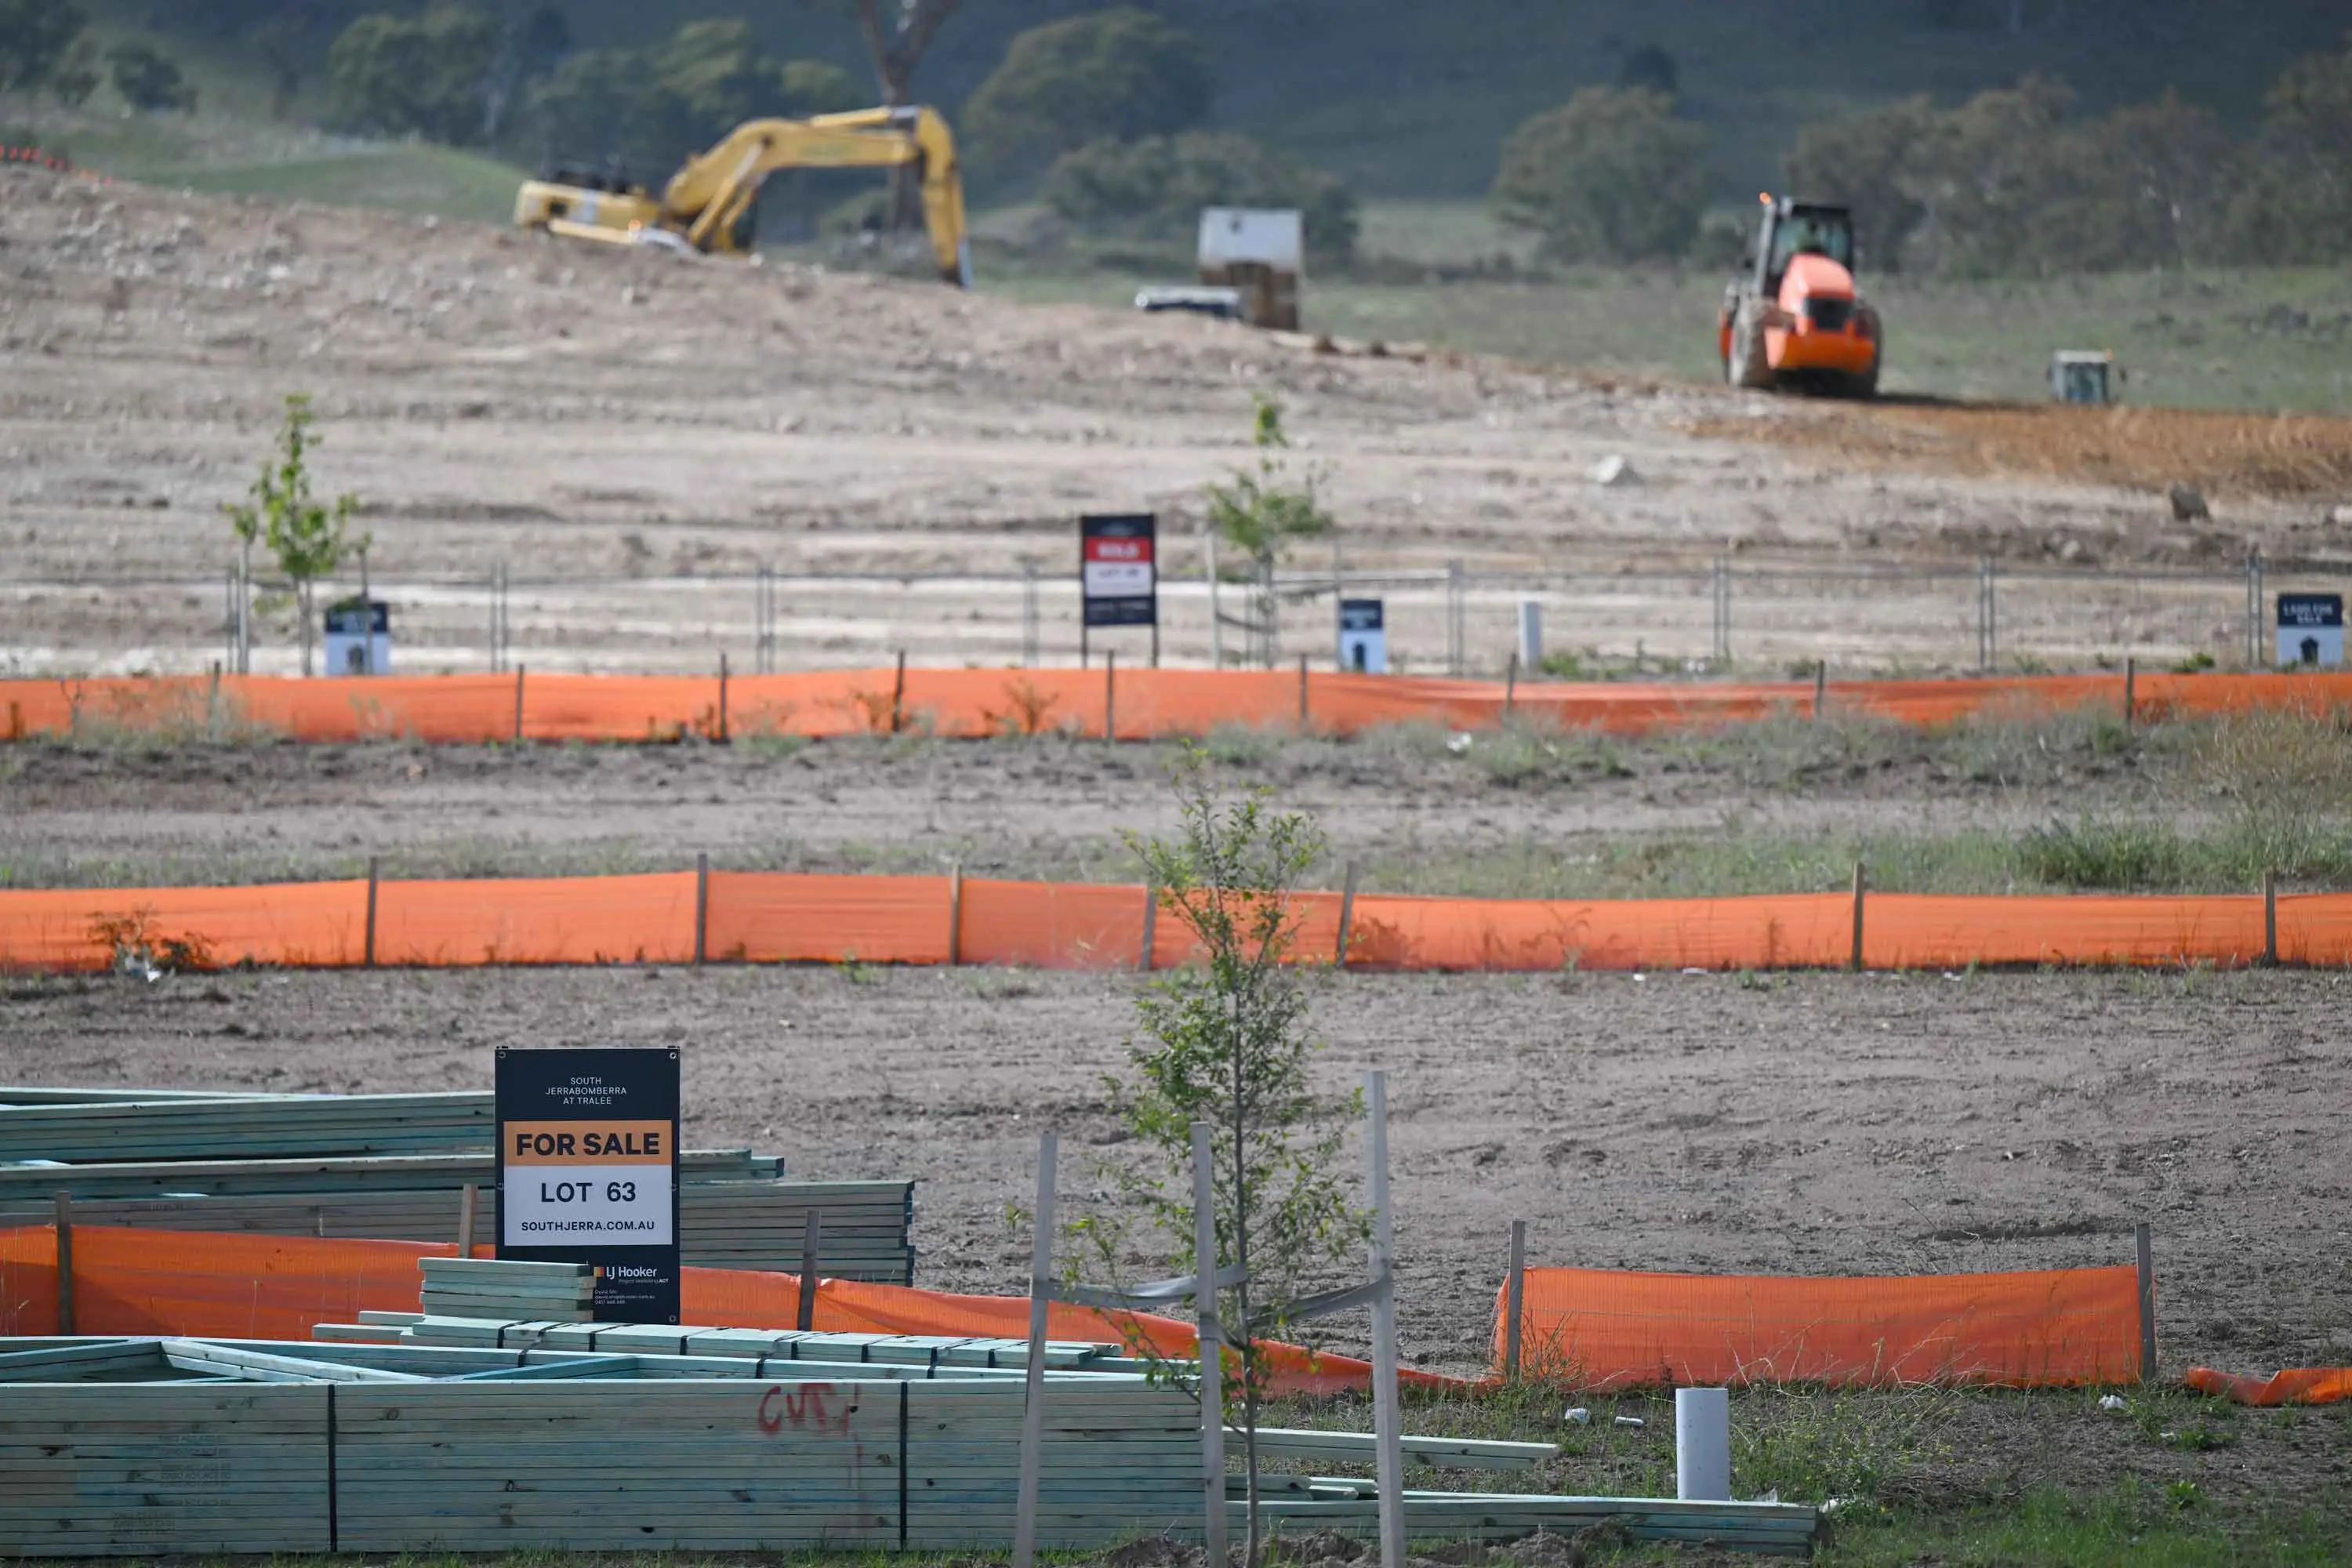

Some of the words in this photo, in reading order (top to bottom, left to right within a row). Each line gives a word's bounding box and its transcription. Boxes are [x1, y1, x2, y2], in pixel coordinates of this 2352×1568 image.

[570, 1076, 602, 1085] SOUTH
[545, 1087, 627, 1095] JERRABOMBERRA
[516, 1133, 576, 1156] FOR
[583, 1132, 660, 1156] SALE
[541, 1182, 593, 1203] LOT
[607, 1181, 637, 1202] 63
[521, 1221, 655, 1232] SOUTHJERRA.COM.AU
[606, 1266, 615, 1280] LJ
[618, 1266, 658, 1277] Hooker
